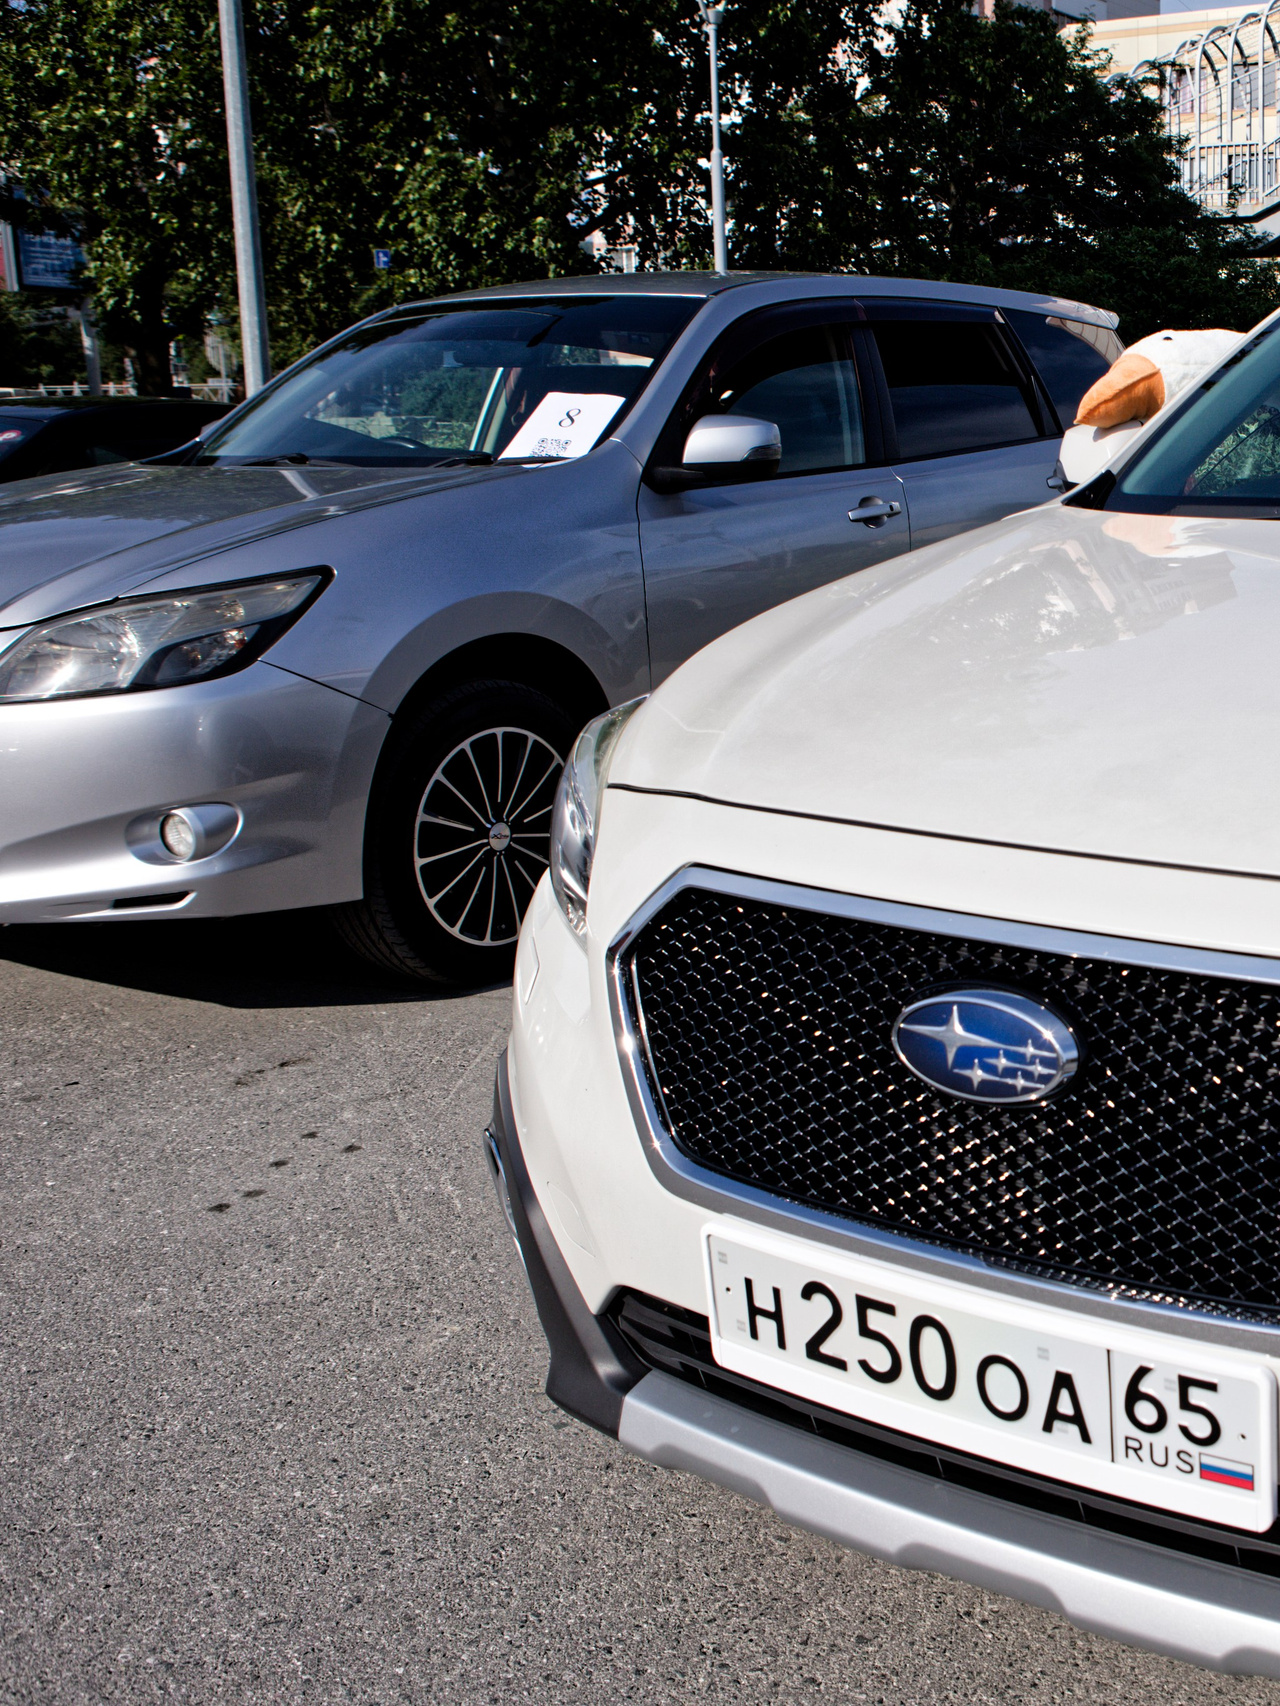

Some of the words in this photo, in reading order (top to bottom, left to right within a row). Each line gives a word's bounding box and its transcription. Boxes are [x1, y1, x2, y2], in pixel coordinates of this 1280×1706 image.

[558, 408, 581, 428] 8
[1124, 1365, 1221, 1447] 65
[1124, 1436, 1195, 1474] RUS
